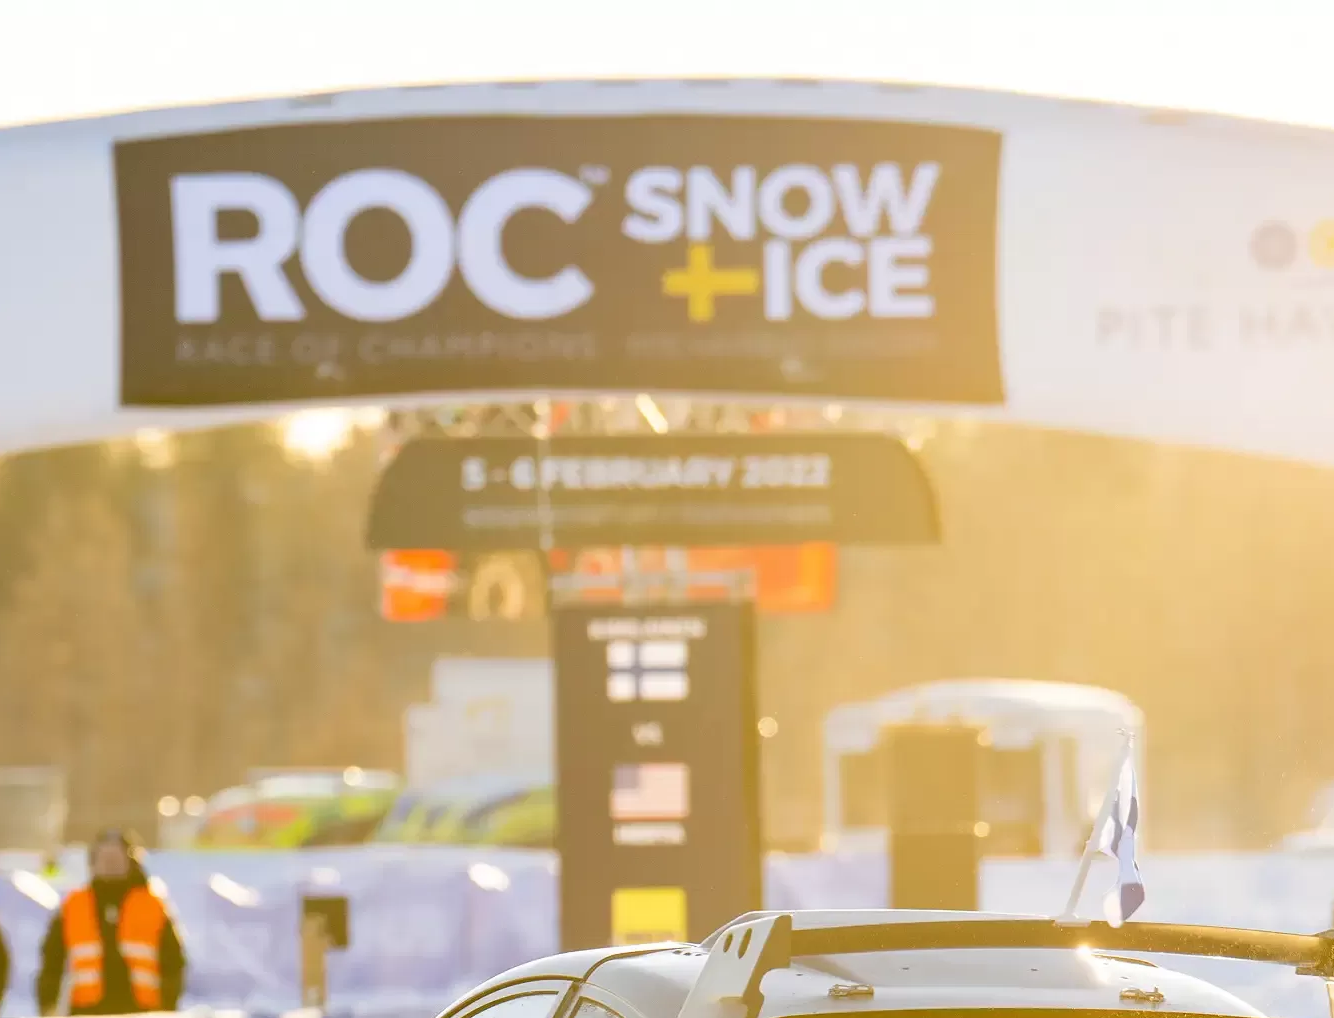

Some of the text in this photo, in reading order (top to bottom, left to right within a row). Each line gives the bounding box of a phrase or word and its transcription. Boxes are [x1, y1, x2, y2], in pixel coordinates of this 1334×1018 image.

[623, 163, 939, 244] SNOW
[170, 166, 594, 323] ROC
[540, 455, 735, 491] FEBRUARY
